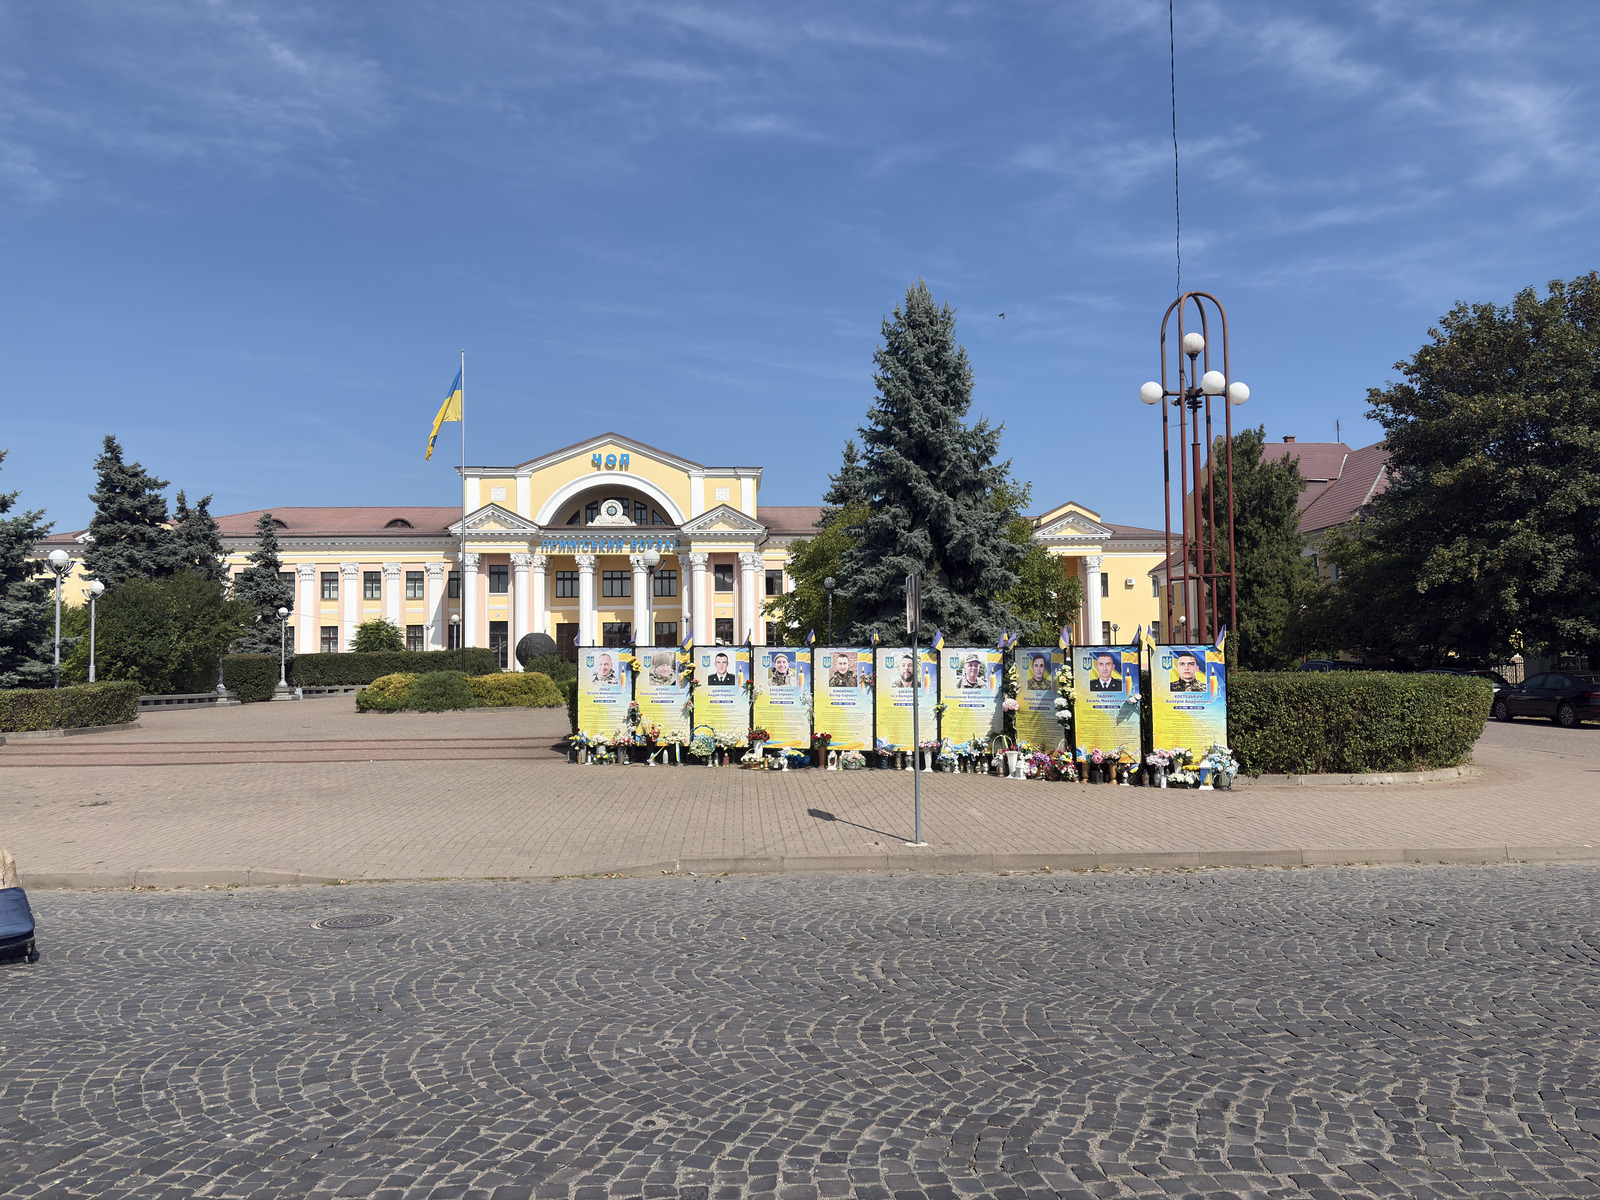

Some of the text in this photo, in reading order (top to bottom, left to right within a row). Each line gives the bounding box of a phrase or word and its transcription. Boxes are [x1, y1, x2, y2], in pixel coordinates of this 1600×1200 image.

[592, 453, 630, 466] ЧОП
[541, 538, 681, 548] ПРИМІСЬКИЙ ВОКЗАЛ
